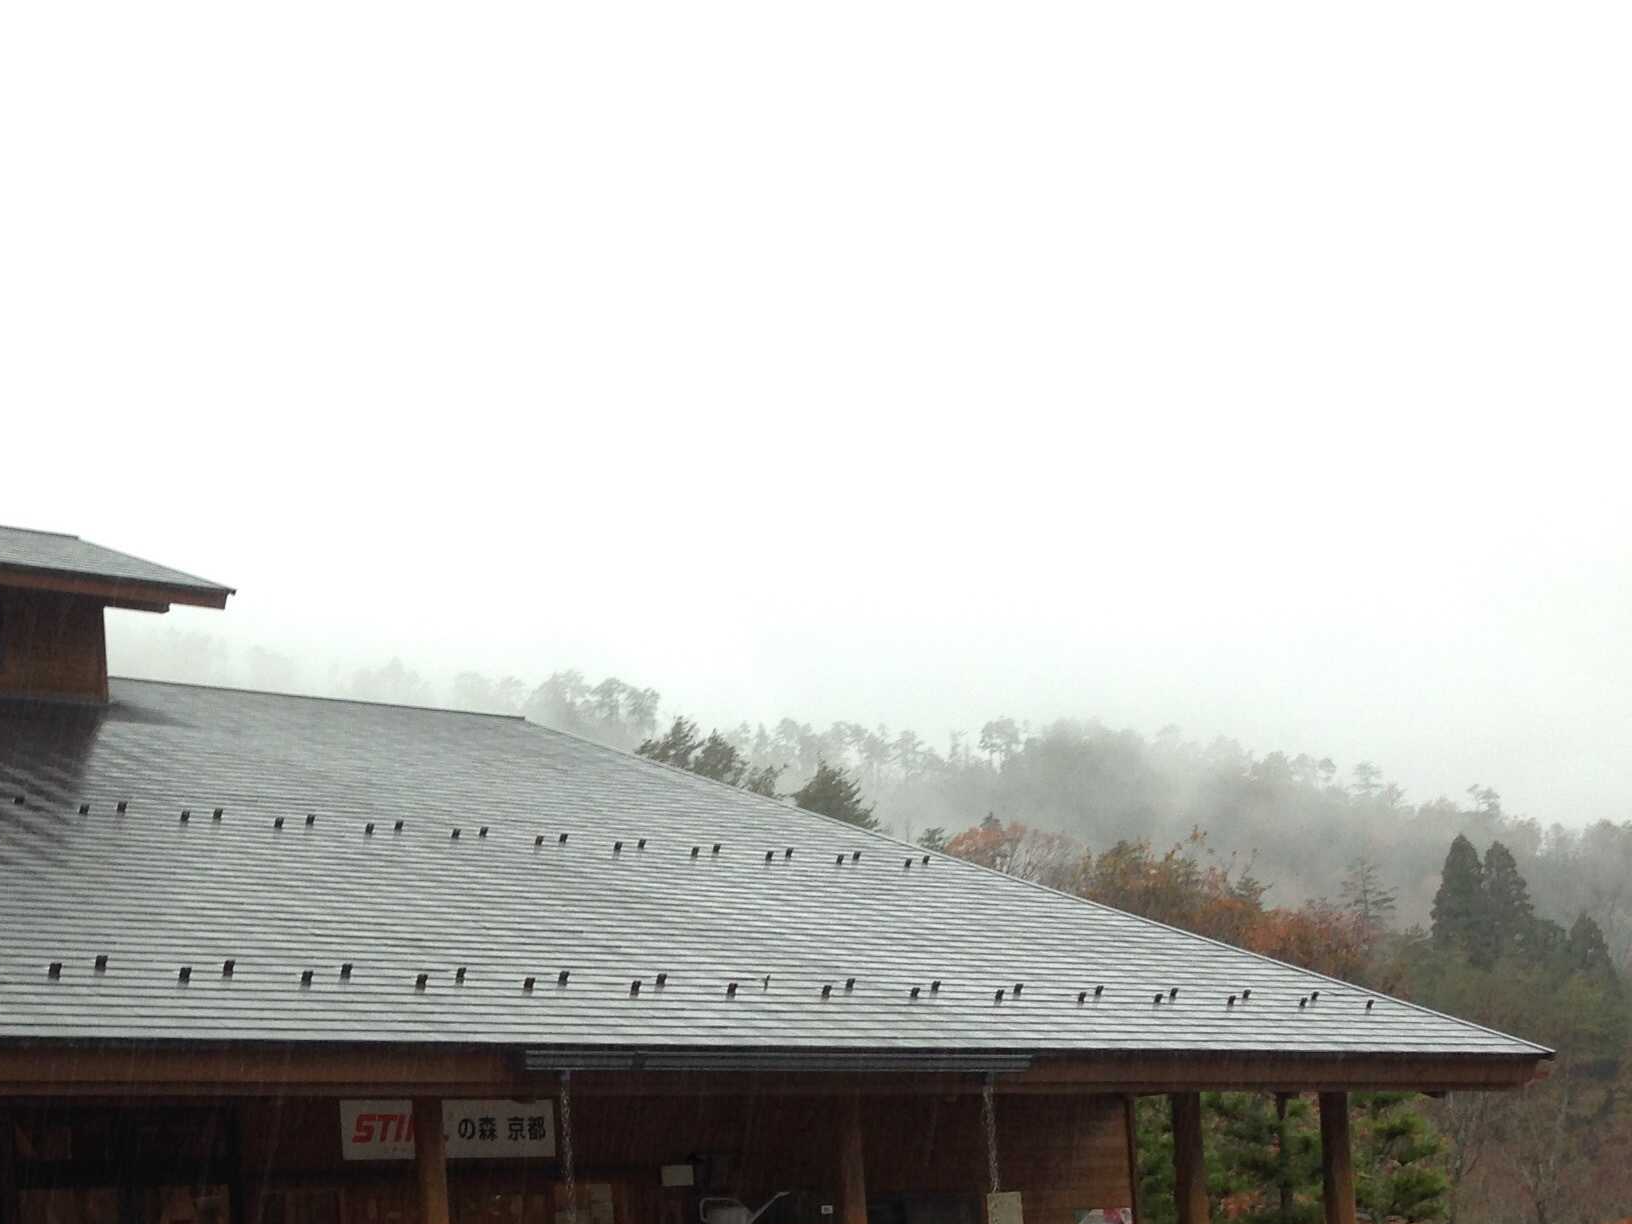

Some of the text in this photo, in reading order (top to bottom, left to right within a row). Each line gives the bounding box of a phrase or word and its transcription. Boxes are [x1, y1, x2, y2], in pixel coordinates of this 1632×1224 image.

[352, 1113, 547, 1143] STI の森 京都
